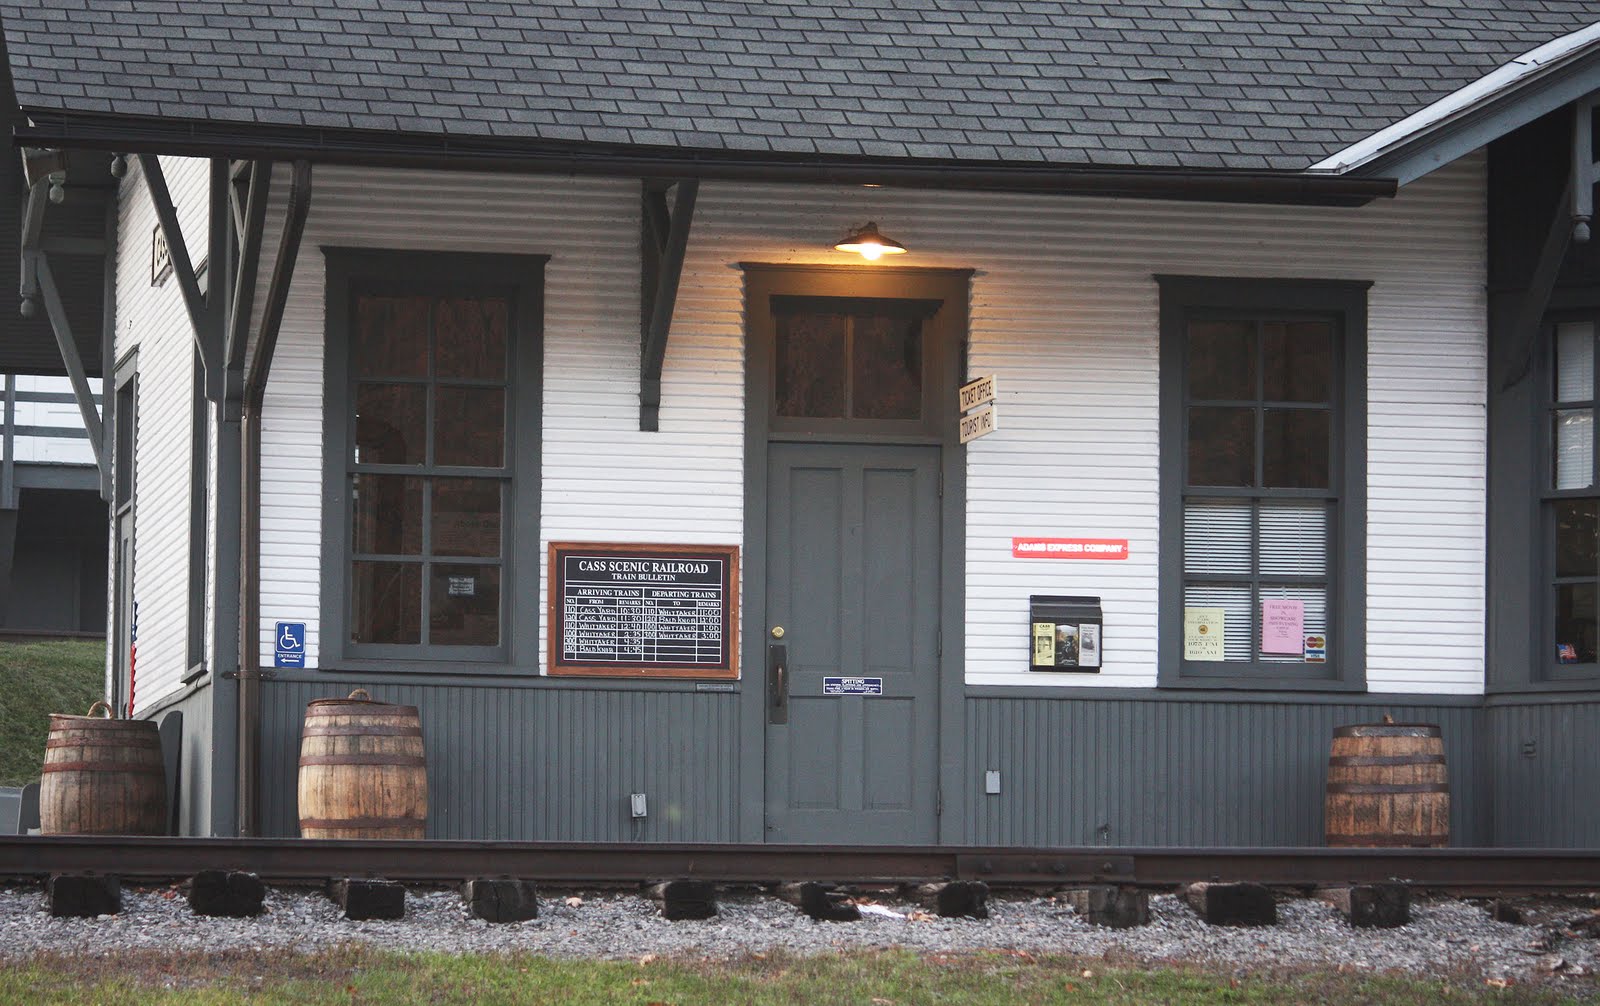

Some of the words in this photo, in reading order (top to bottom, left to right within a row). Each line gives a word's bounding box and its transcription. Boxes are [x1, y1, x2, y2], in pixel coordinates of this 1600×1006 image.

[962, 386, 976, 406] TICKET
[977, 380, 991, 400] OFFICE
[962, 416, 979, 438] TOURIST
[981, 412, 991, 429] INFO
[1018, 543, 1046, 551] ADAMS
[1047, 544, 1083, 552] EXPRESS
[1084, 544, 1122, 552] COMPANY
[579, 561, 606, 571] CASS
[609, 562, 649, 572] SCENIC
[652, 563, 708, 574] RAILROAD
